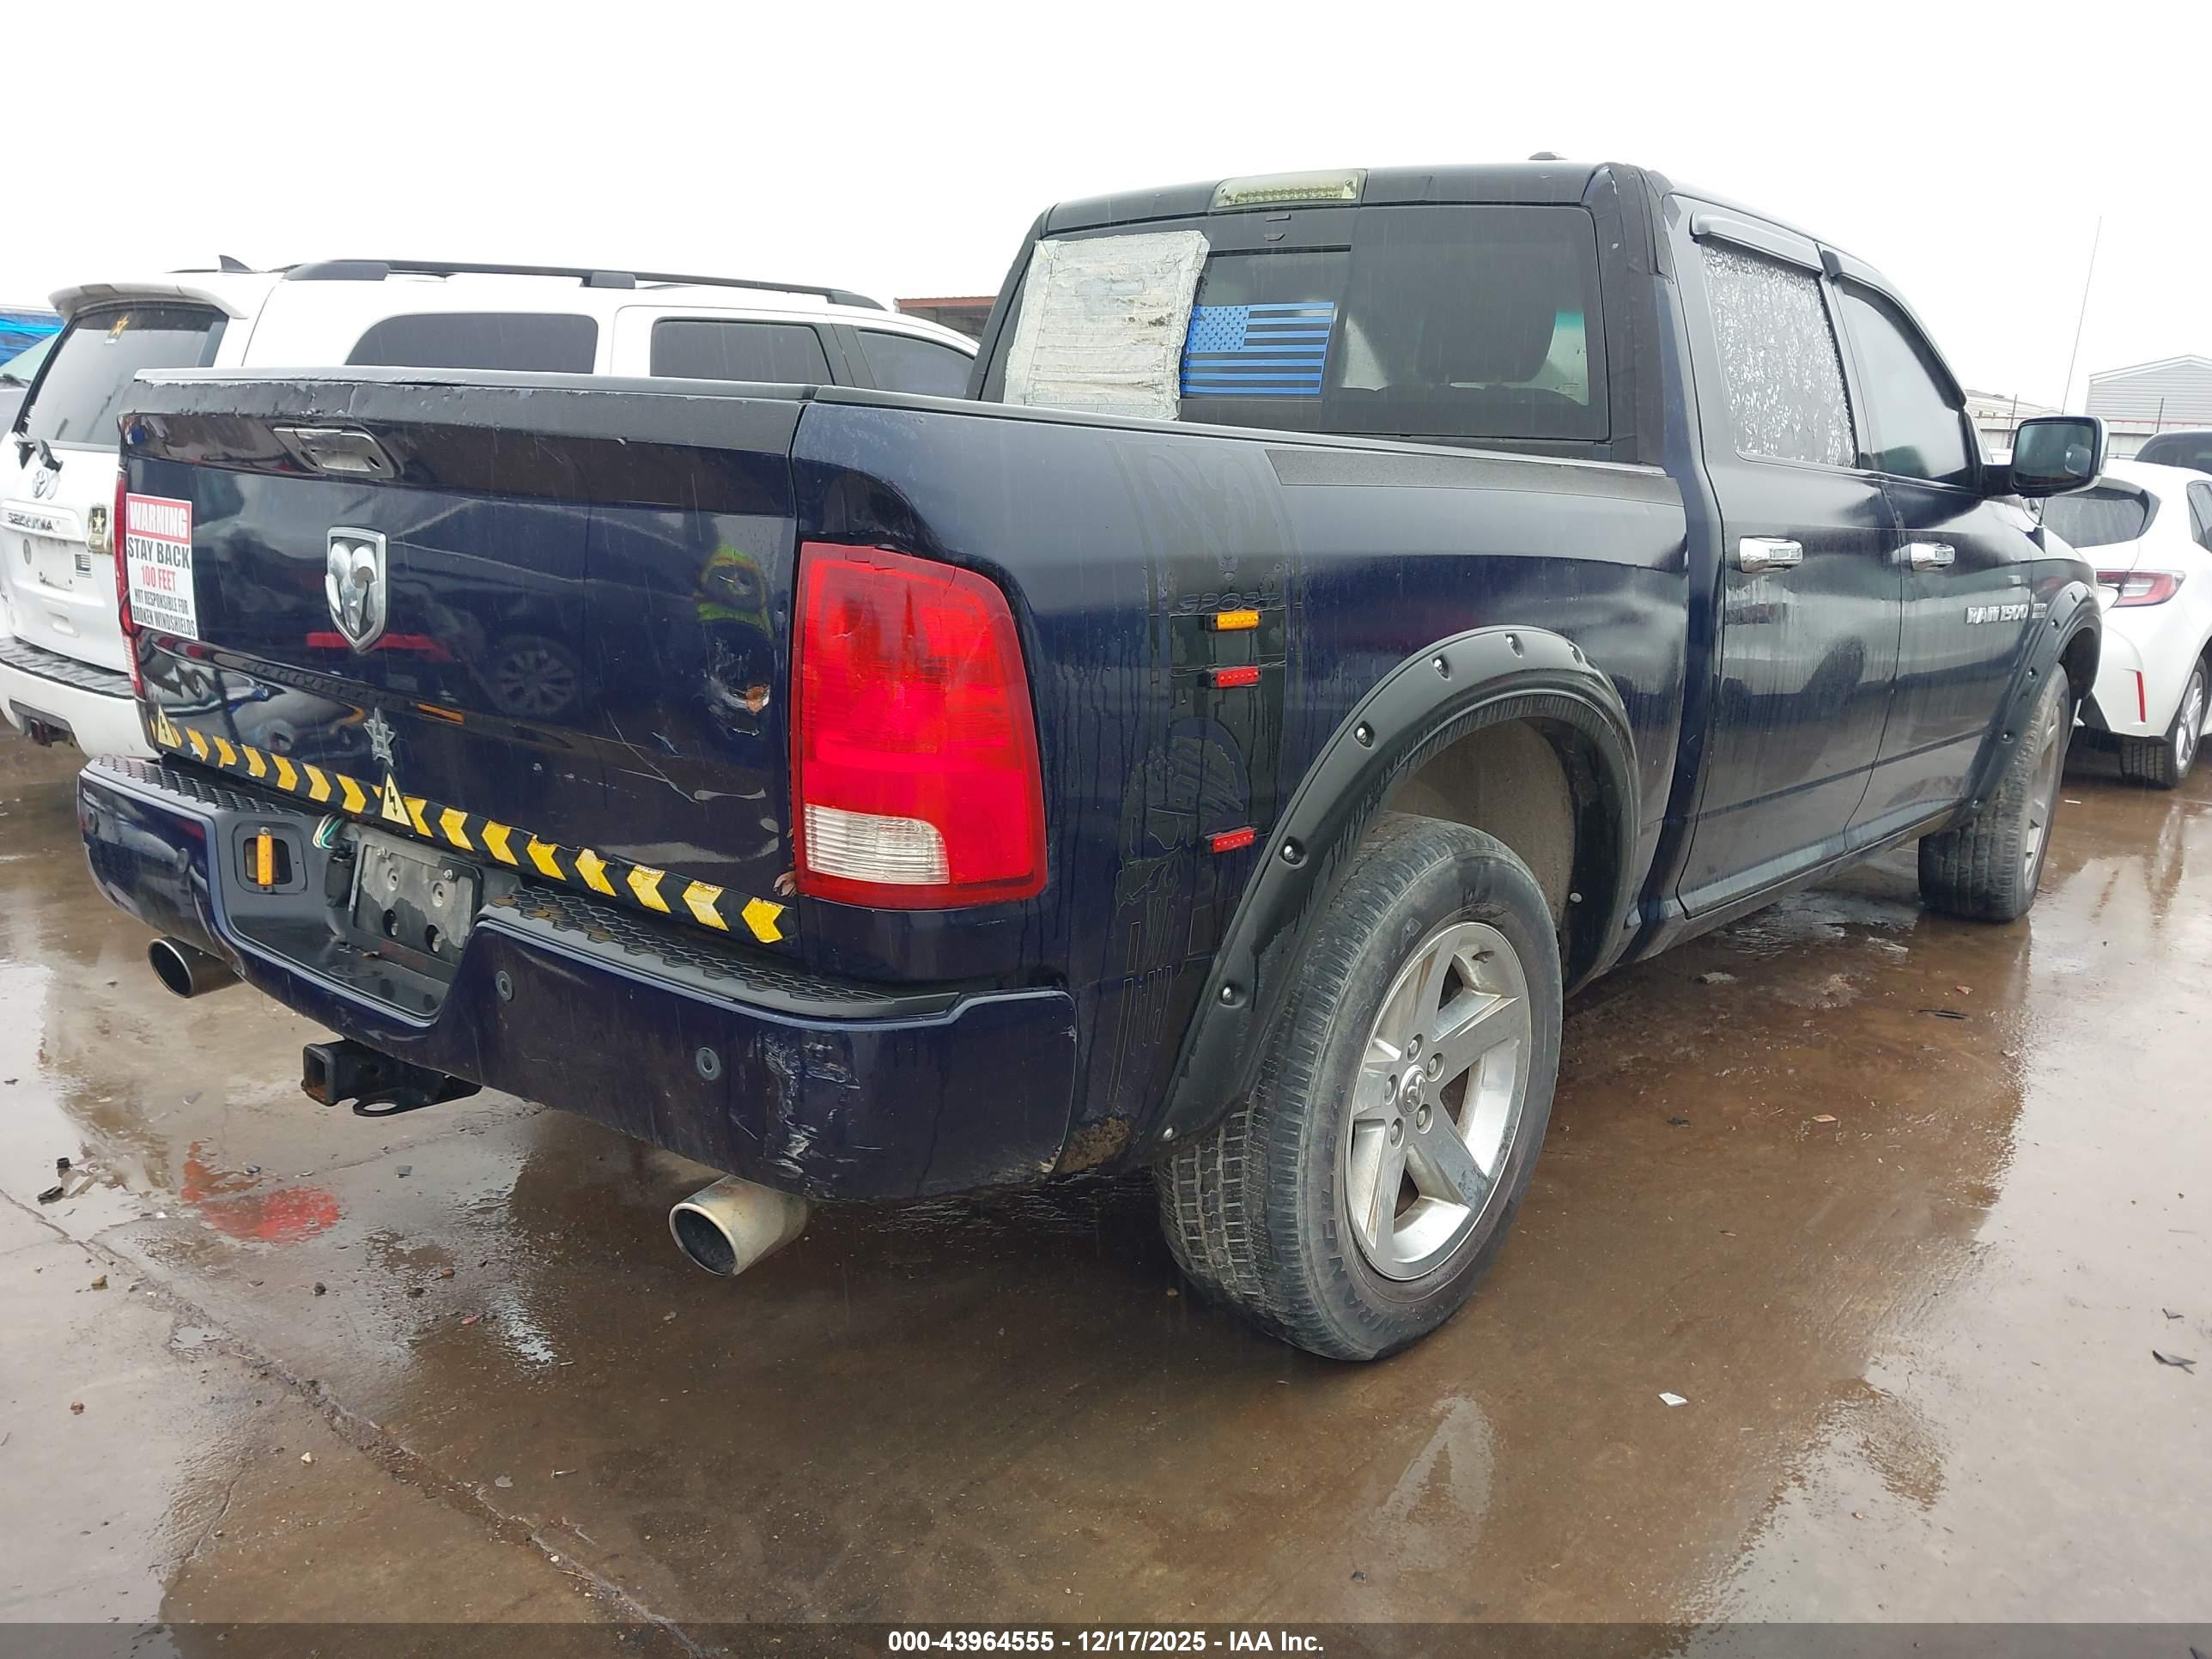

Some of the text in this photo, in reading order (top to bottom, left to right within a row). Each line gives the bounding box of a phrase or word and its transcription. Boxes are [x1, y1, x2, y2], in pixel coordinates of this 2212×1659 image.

[130, 501, 188, 538] WARNING
[128, 537, 190, 569] STAY BACK
[142, 566, 176, 592] 100 FEET
[134, 588, 188, 615] NOT RESPONSIBLE FOR
[1966, 605, 2000, 624] RAM
[132, 605, 196, 636] BROKEN WINDSHIELDS
